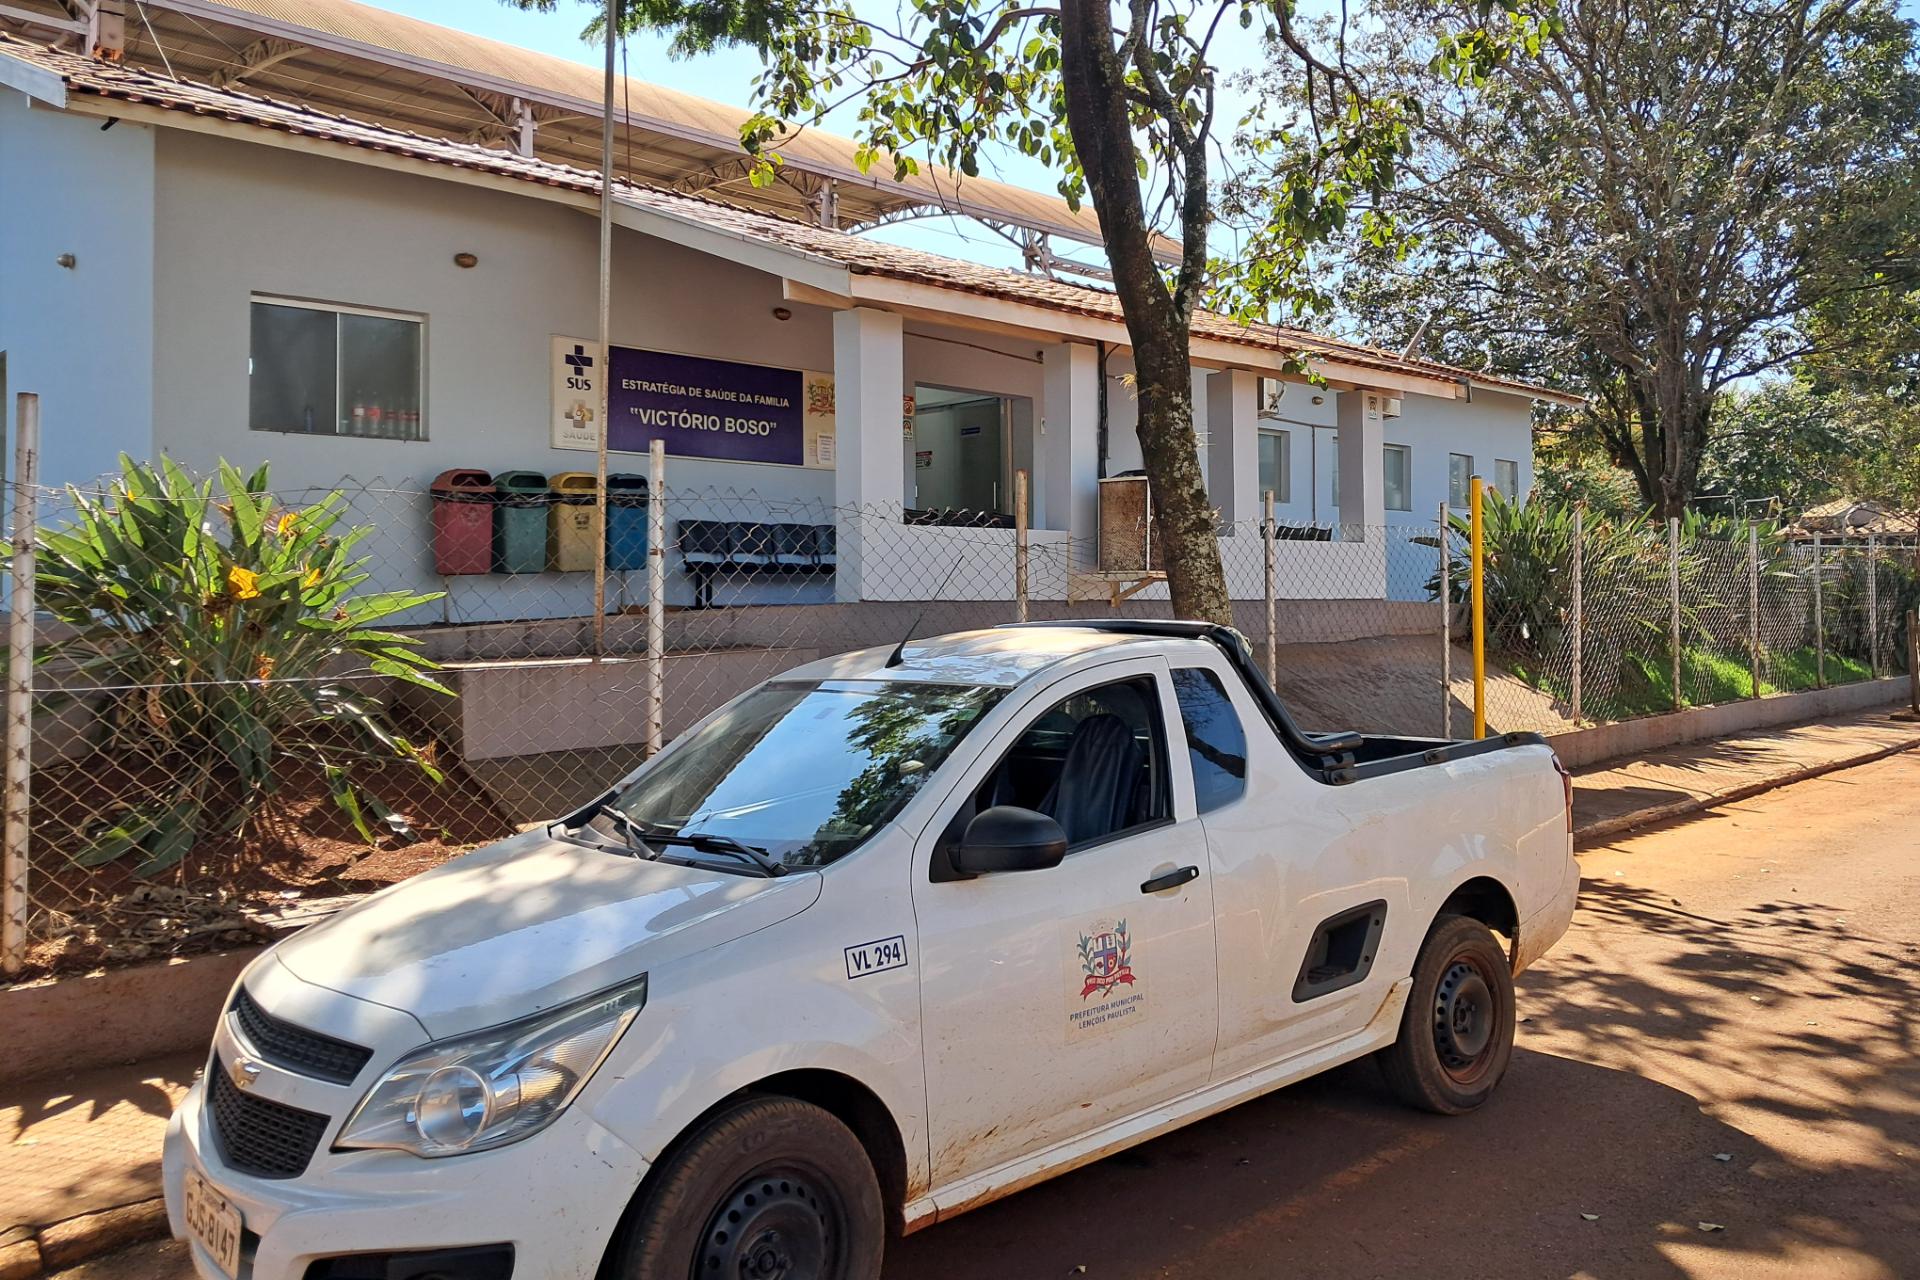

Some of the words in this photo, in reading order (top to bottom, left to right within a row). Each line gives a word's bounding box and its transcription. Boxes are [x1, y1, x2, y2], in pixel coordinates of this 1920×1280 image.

[567, 377, 592, 391] SUS
[622, 379, 687, 396] ESTRATÉGIA
[688, 387, 702, 398] DE
[704, 388, 737, 402] SAÚDE
[739, 393, 753, 403] DA
[852, 950, 871, 971] VL
[875, 942, 901, 967] 294
[1070, 1004, 1109, 1021] PREFEITURA
[1111, 993, 1144, 1009] MUNICIPAL
[1107, 1006, 1136, 1021] PAULISTA
